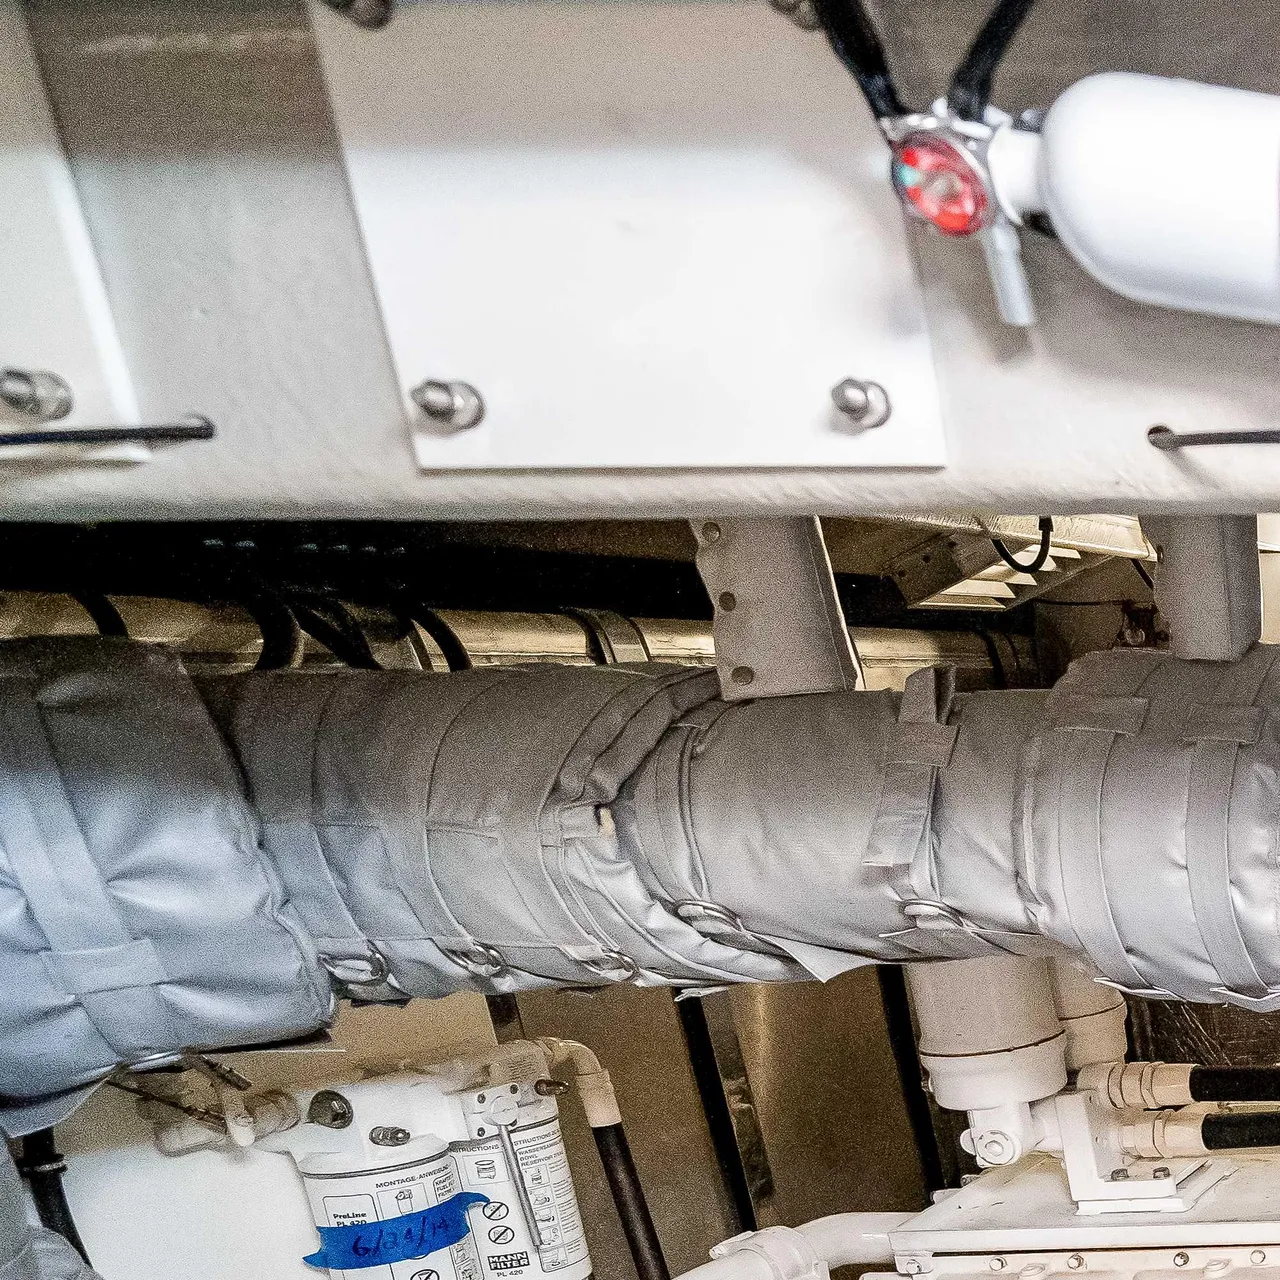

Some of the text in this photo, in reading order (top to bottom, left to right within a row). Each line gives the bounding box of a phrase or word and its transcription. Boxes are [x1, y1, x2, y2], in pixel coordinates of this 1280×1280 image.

[332, 1212, 367, 1220] PreLine
[488, 1252, 527, 1264] MANN
[490, 1258, 530, 1270] FILTER
